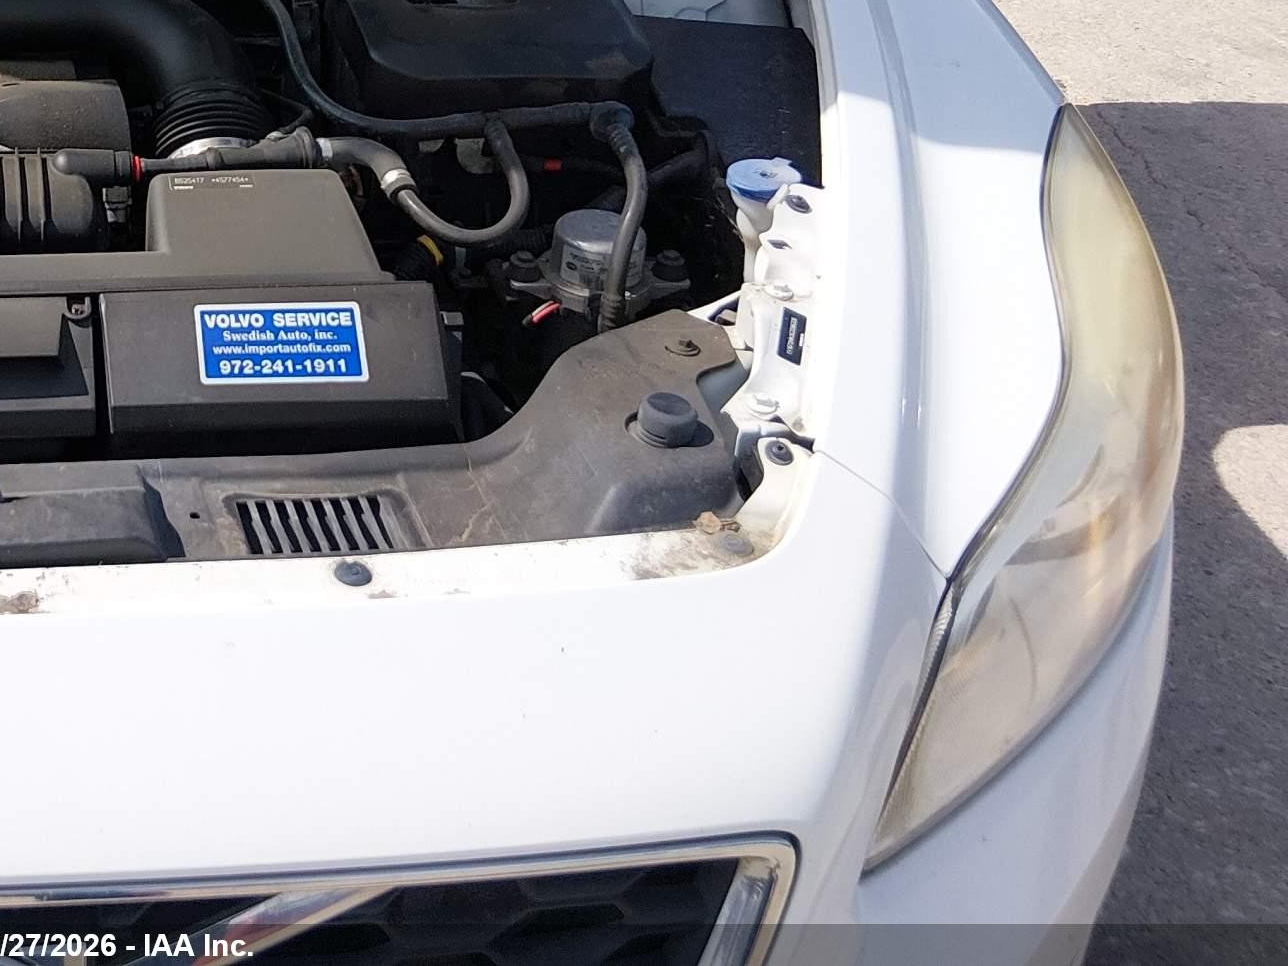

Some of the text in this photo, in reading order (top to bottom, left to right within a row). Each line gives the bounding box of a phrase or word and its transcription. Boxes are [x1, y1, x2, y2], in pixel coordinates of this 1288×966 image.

[204, 311, 353, 328] VOLVO SERVICE
[222, 328, 338, 342] Swedish Auto, inc.
[212, 342, 352, 356] www.importautofix.com
[219, 358, 348, 375] 972-241-1911
